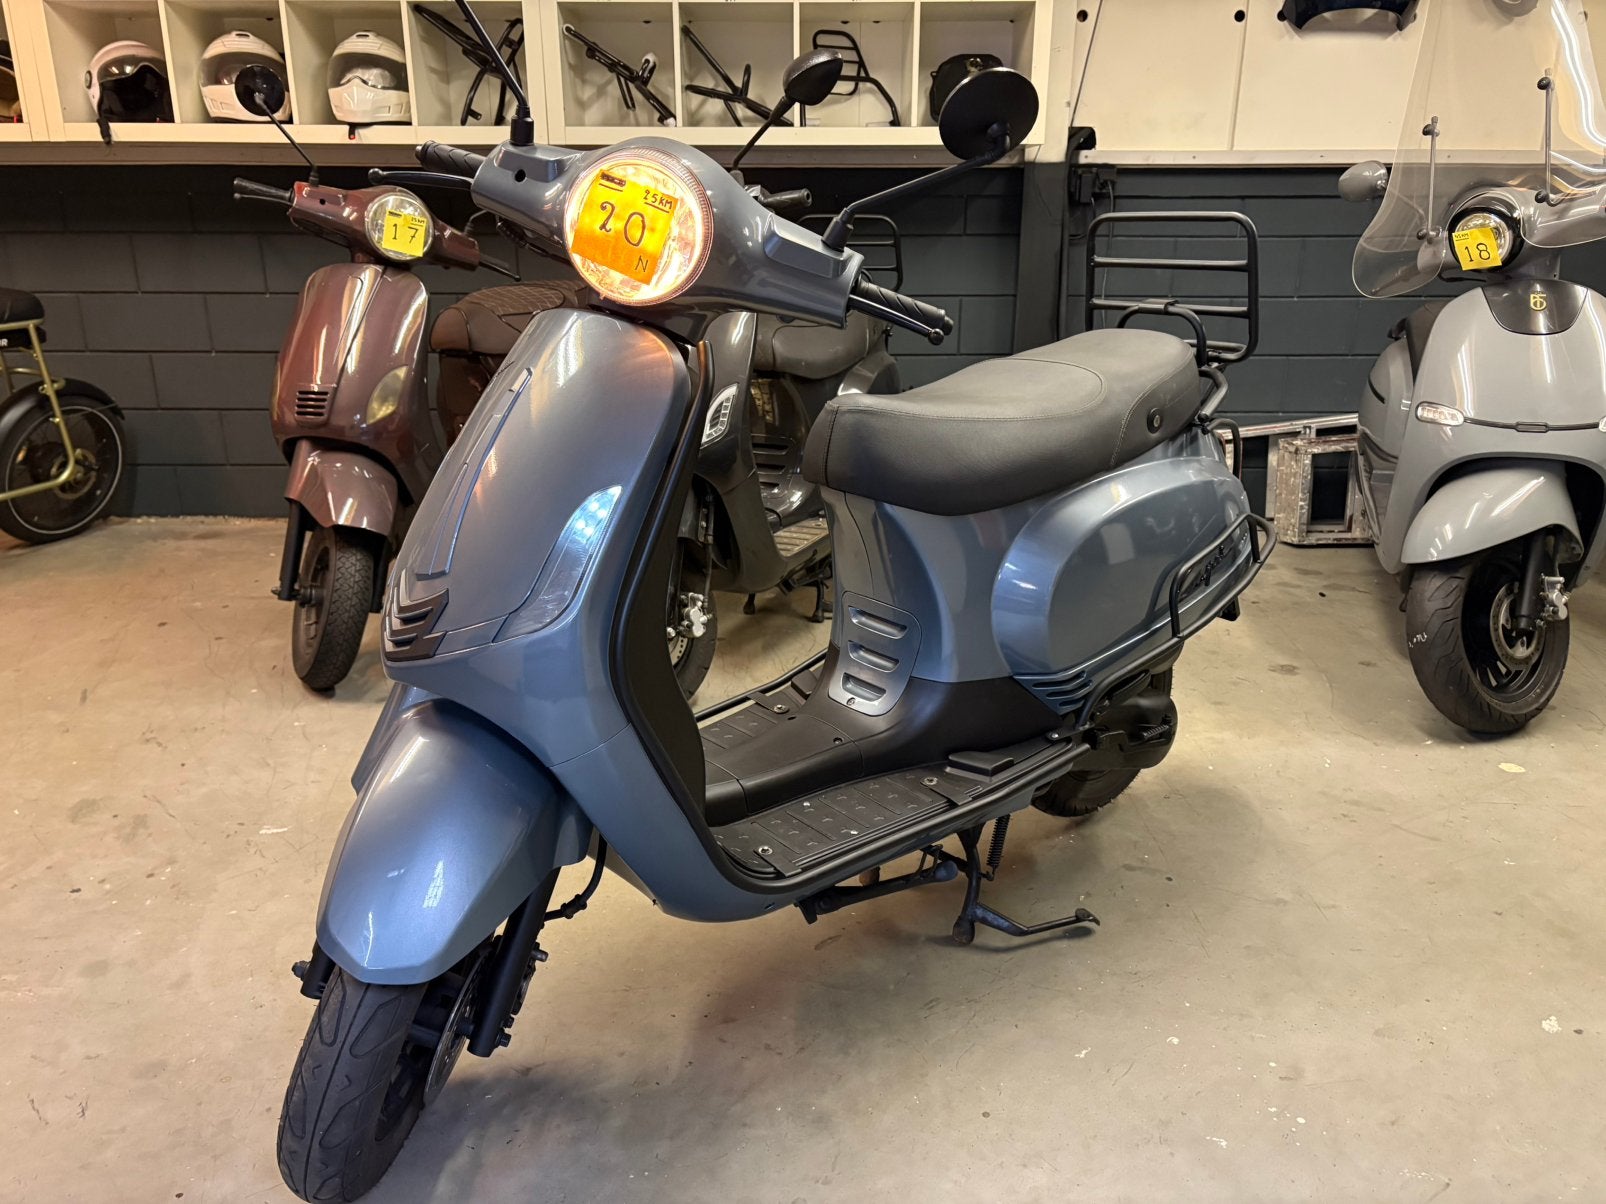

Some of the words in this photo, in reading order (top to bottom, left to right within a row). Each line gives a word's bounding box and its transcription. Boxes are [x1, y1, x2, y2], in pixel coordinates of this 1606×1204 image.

[392, 223, 419, 244] 17
[599, 201, 647, 247] 20
[1465, 242, 1491, 262] 18
[635, 255, 648, 272] N
